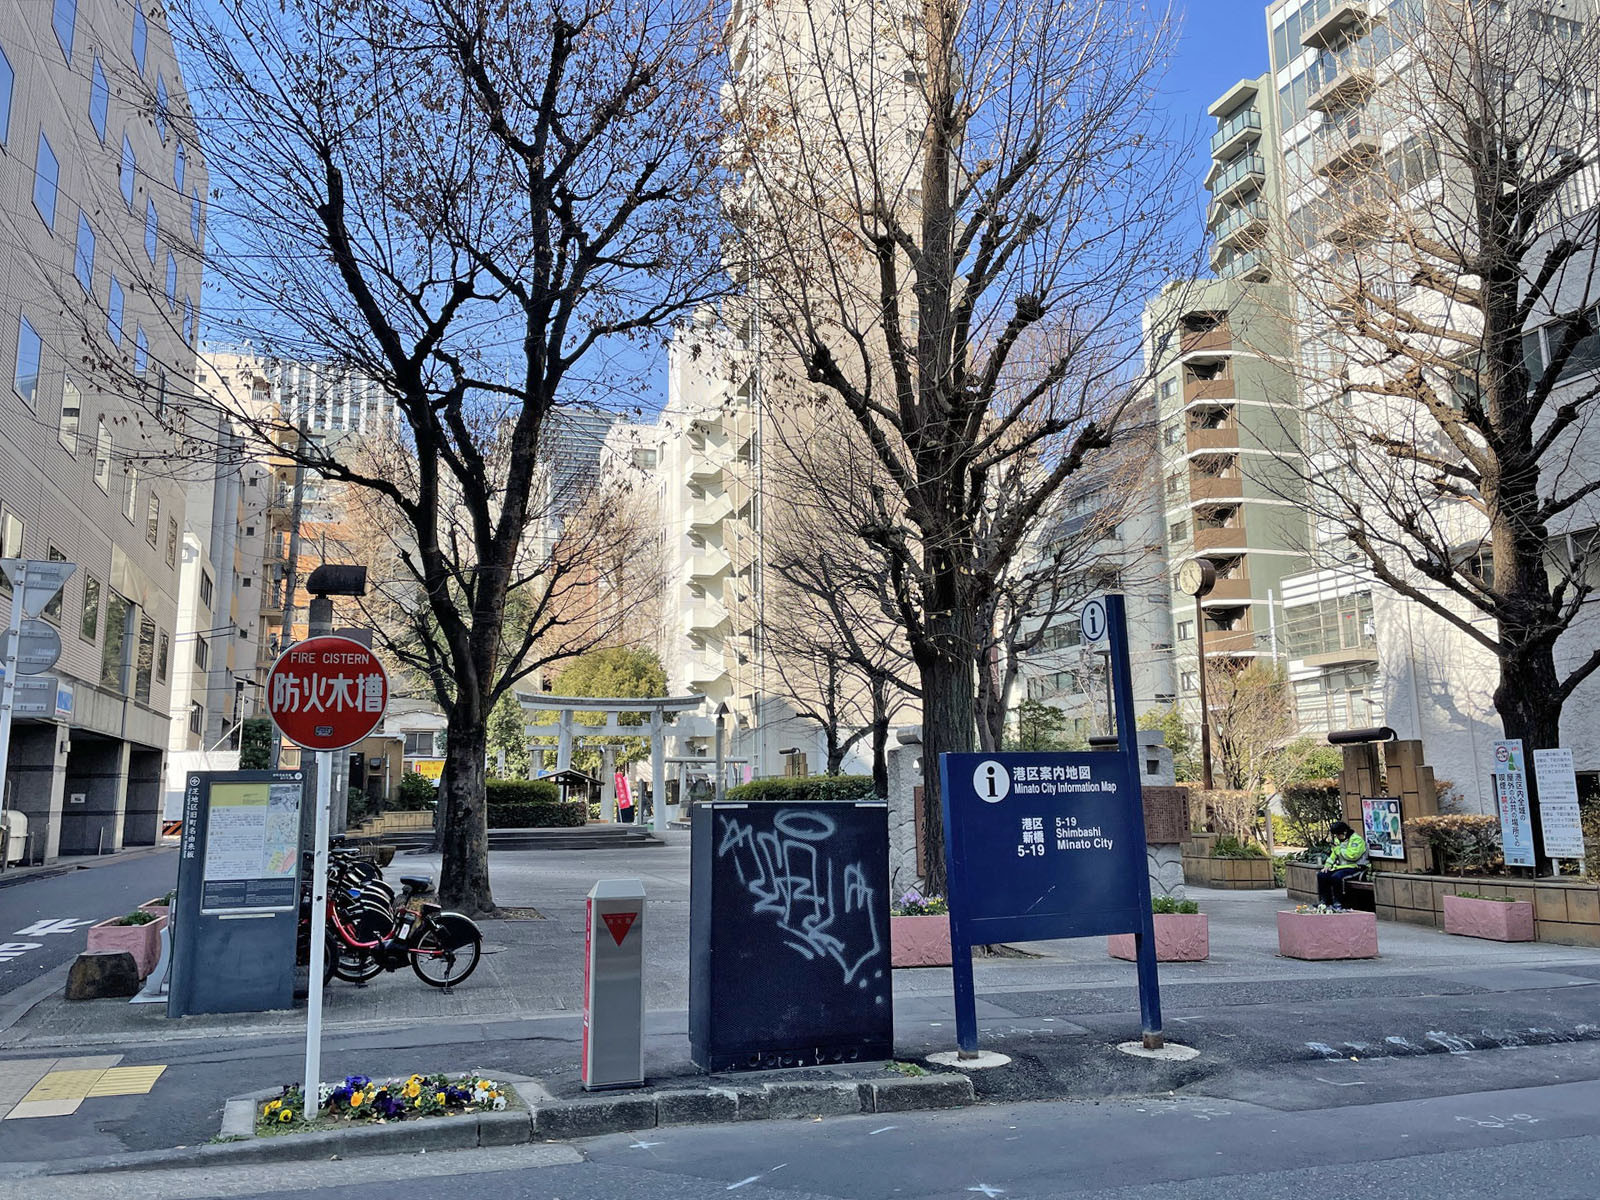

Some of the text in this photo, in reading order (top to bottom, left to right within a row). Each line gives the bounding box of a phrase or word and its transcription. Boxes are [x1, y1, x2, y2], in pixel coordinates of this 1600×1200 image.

[290, 652, 370, 664] FIRE CISTERN
[1013, 766, 1091, 781] 港区案内地図
[1014, 781, 1117, 795] Minato City Information Map
[1022, 818, 1043, 831] 港区
[1055, 817, 1077, 827] 5-19
[1022, 831, 1045, 844] 新橋
[1056, 827, 1101, 839] Shimbashi
[1017, 845, 1045, 857] 5-19
[1057, 838, 1113, 851] Minato City
